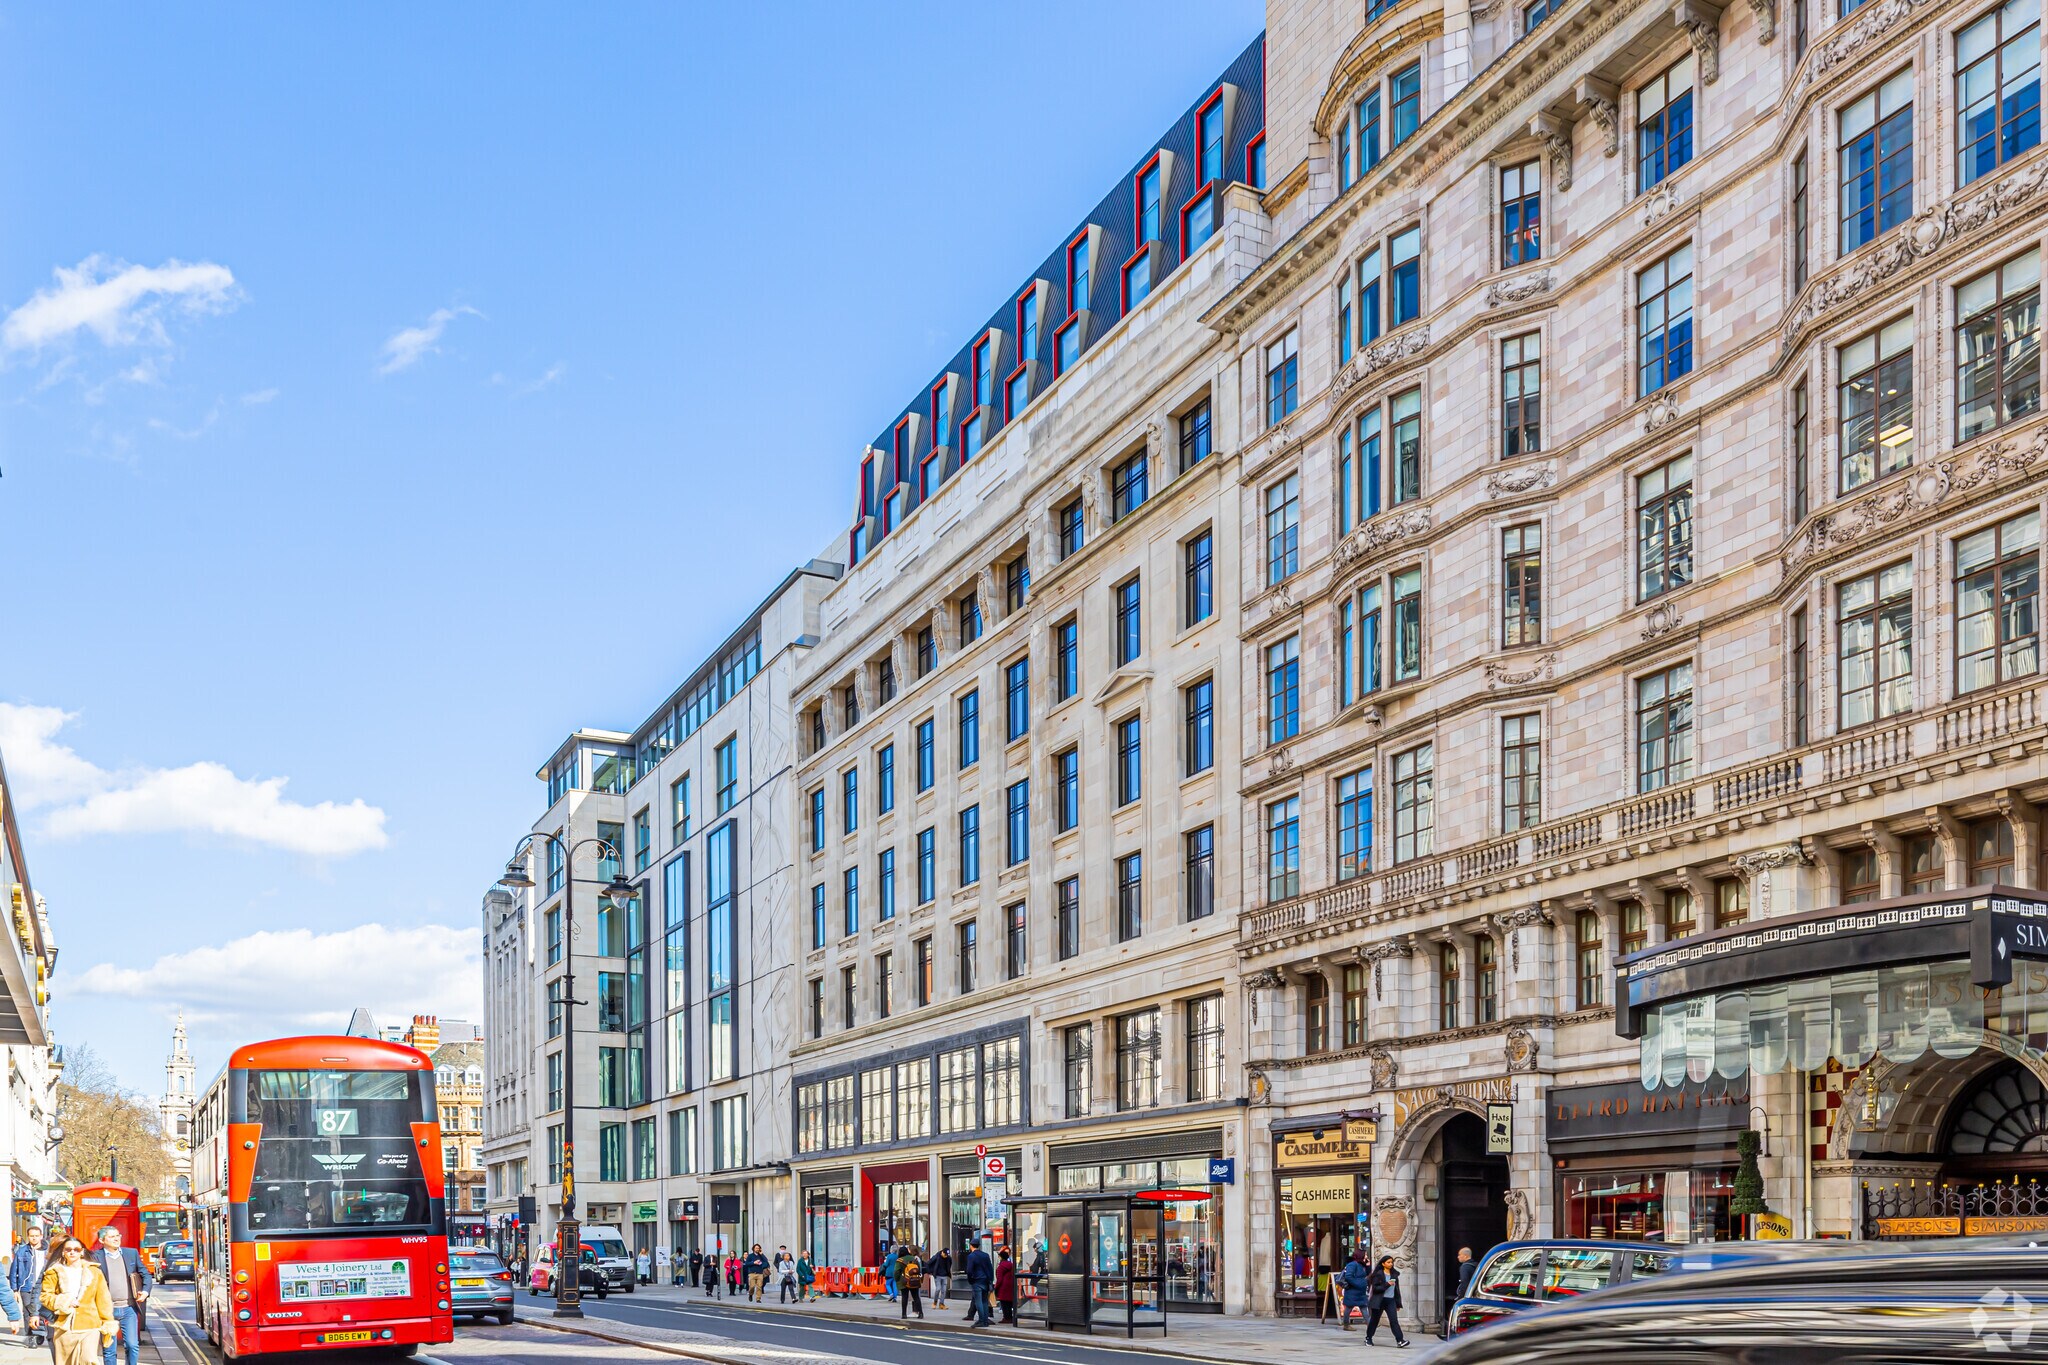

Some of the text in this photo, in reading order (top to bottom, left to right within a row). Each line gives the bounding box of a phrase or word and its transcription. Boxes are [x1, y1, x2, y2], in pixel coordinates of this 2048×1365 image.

[322, 1110, 352, 1132] 87
[1491, 1113, 1509, 1122] Hats
[1348, 1126, 1374, 1136] CASHMERE
[1490, 1135, 1509, 1145] Caps
[1284, 1142, 1360, 1157] CASHMERE
[1295, 1188, 1351, 1202] CASHMERE
[295, 1264, 321, 1274] West
[323, 1264, 330, 1273] 4
[331, 1263, 368, 1274] Joinery
[351, 1332, 367, 1340] EWY
